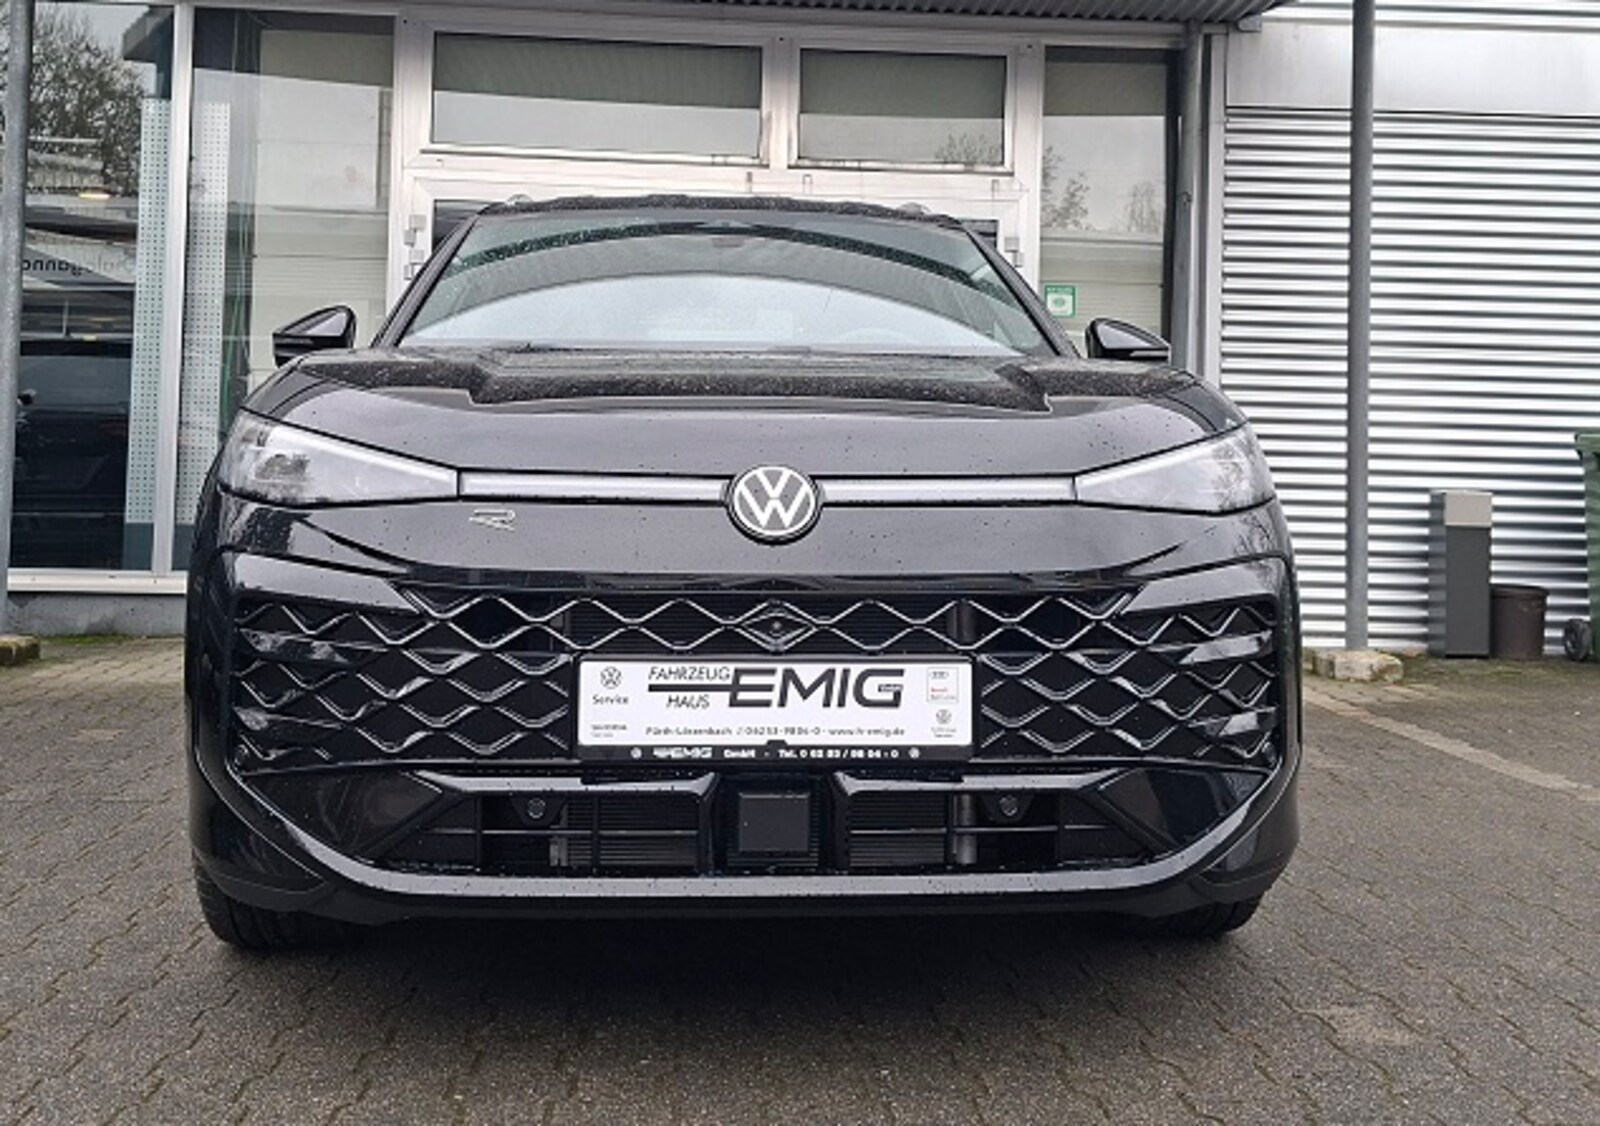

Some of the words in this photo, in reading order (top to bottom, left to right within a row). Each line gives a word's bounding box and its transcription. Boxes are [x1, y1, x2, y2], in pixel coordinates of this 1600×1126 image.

[648, 666, 731, 680] FAHRZEUG
[729, 667, 905, 708] EMIG
[592, 694, 629, 705] Service
[666, 694, 711, 709] HAUS
